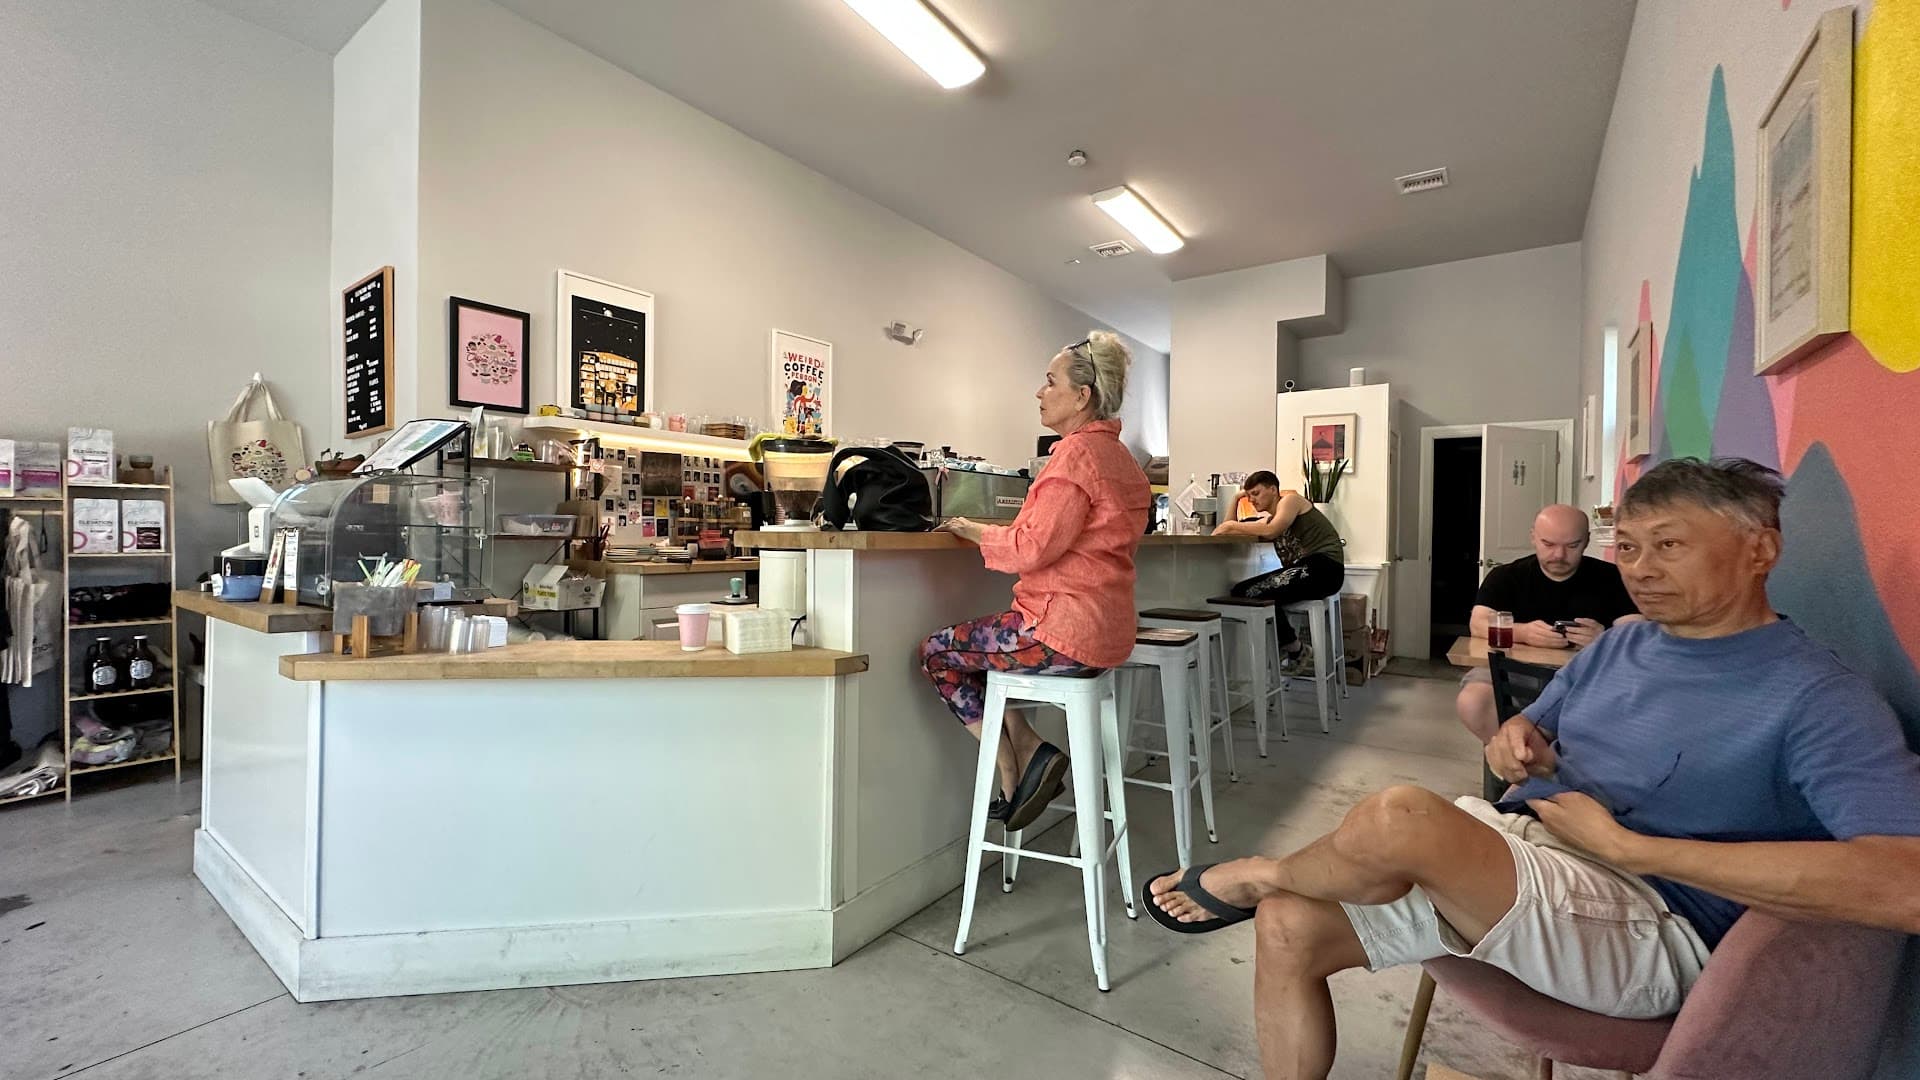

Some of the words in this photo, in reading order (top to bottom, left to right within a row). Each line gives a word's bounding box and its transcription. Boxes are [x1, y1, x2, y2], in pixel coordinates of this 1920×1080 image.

[788, 352, 821, 368] WEIRD
[784, 362, 824, 379] COFFEE
[791, 371, 817, 383] PERSON
